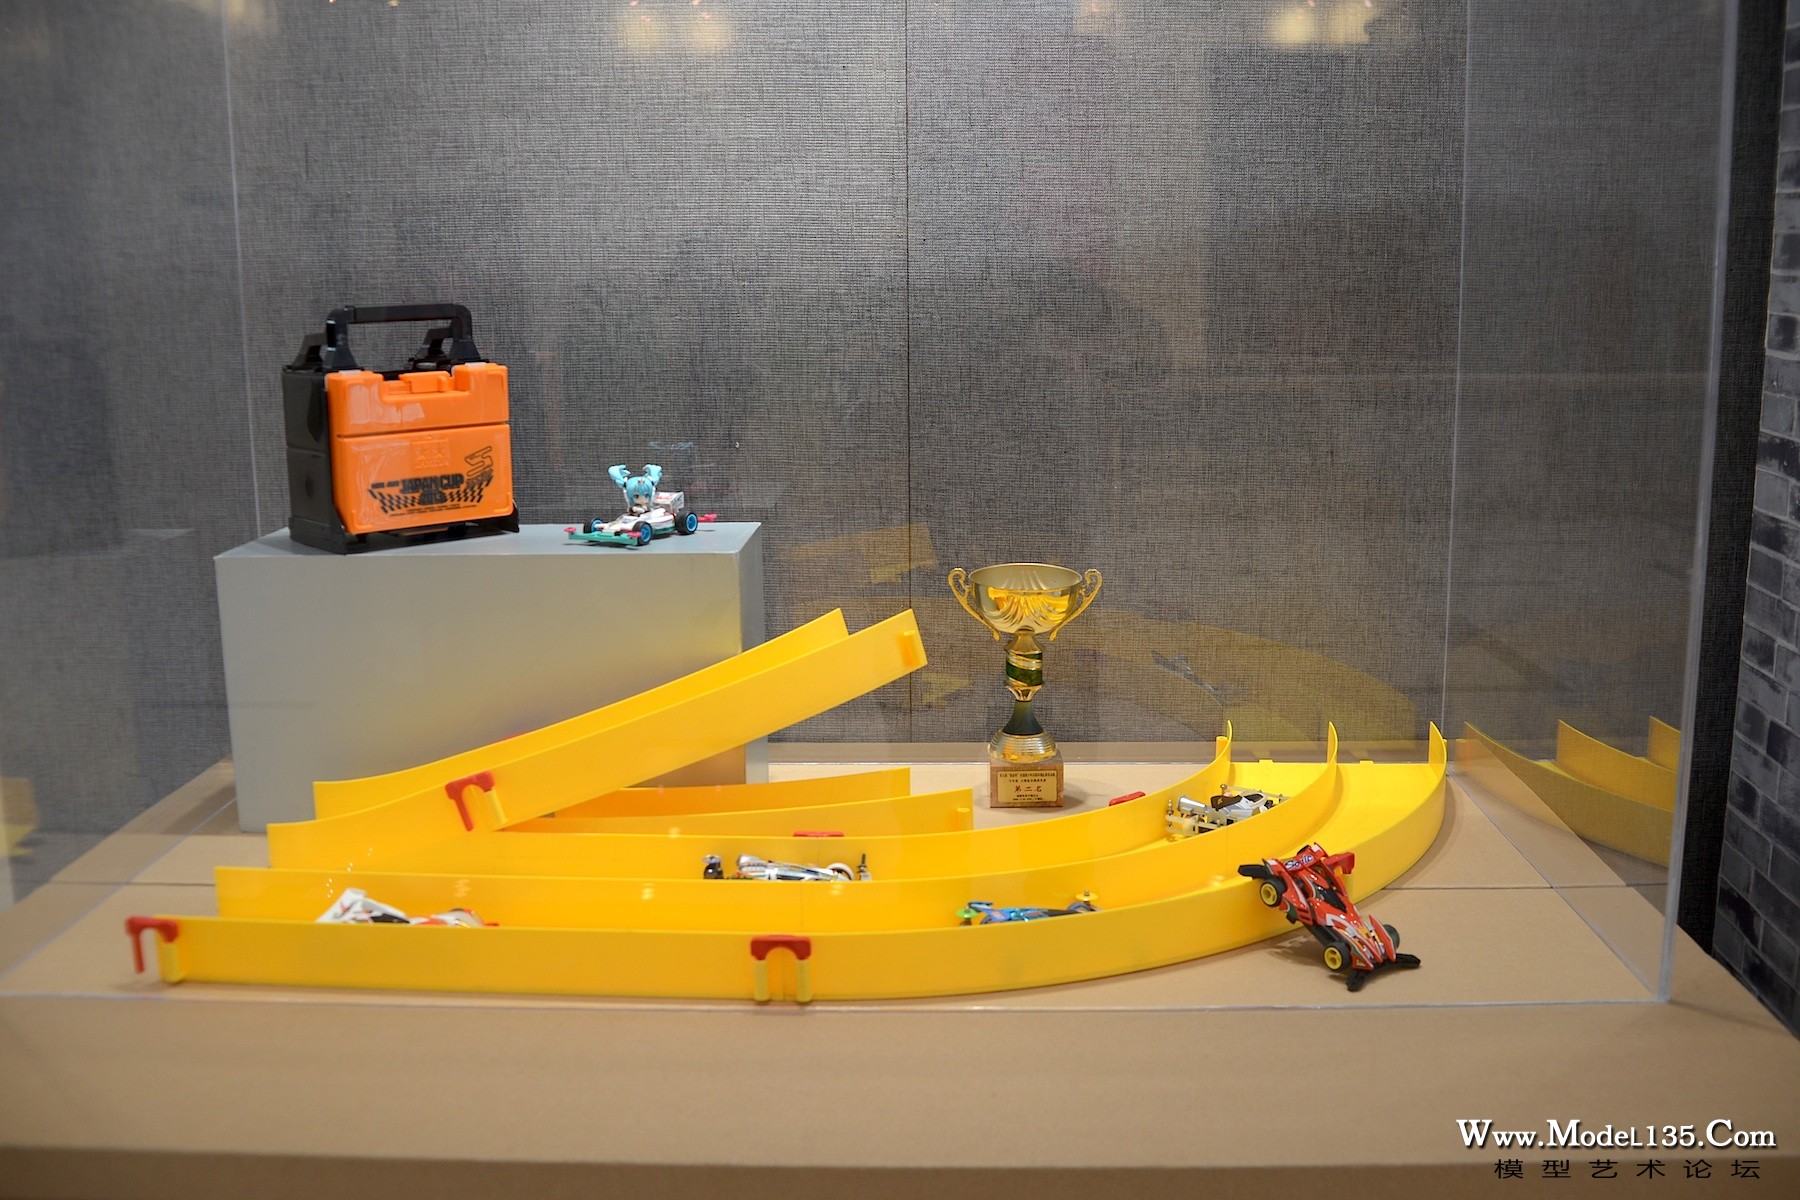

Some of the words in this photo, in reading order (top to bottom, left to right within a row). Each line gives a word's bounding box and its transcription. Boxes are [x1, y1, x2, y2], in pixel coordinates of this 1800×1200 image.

[400, 476, 439, 494] JAPAN
[439, 473, 464, 490] CUP
[1014, 785, 1043, 793] 第二名
